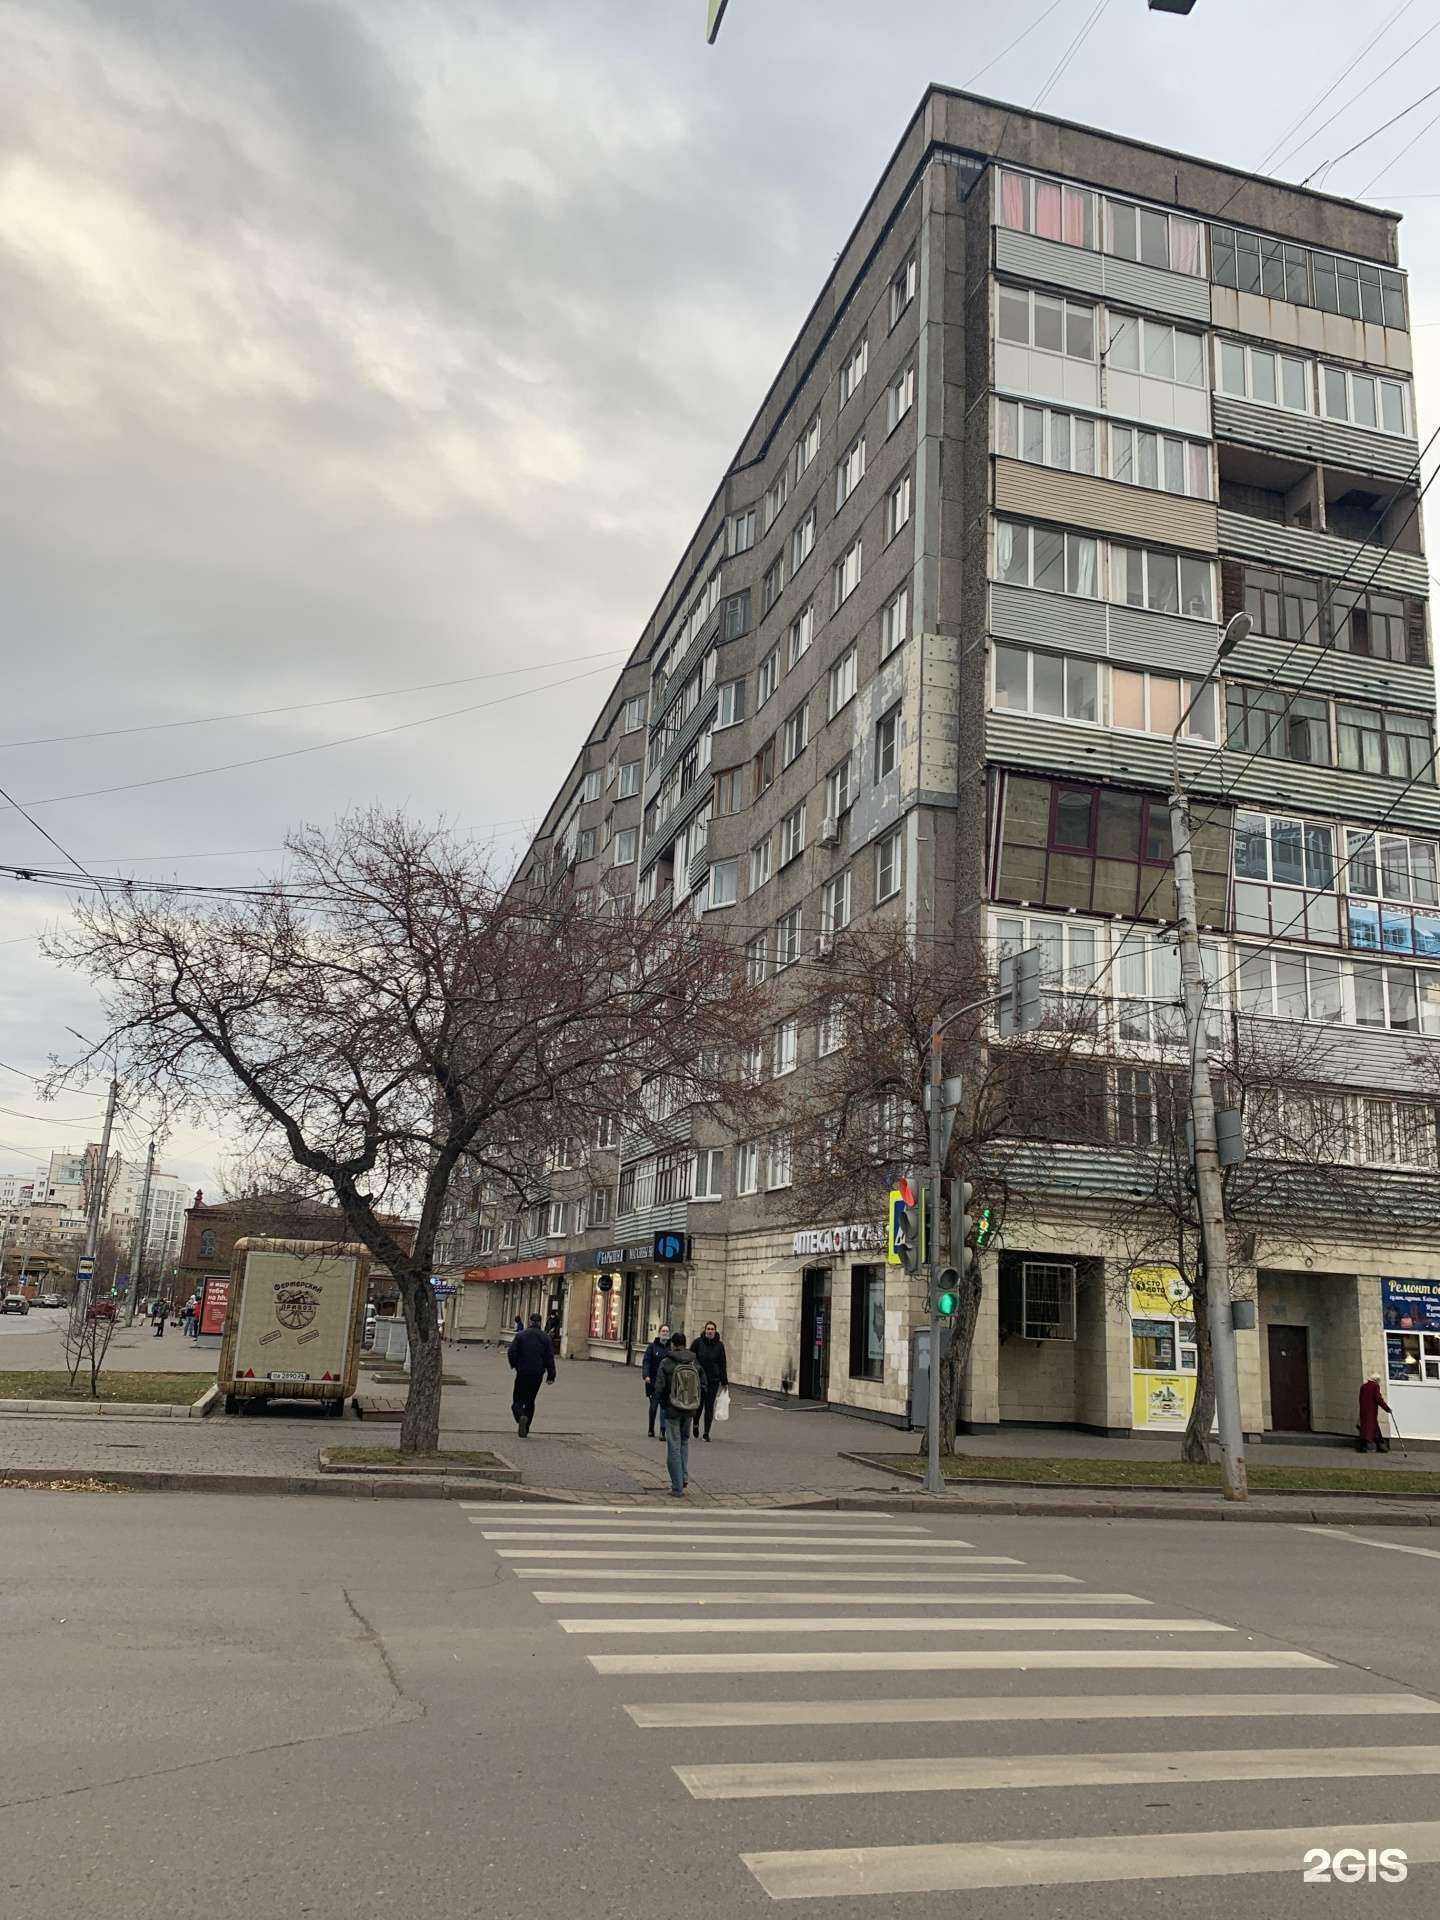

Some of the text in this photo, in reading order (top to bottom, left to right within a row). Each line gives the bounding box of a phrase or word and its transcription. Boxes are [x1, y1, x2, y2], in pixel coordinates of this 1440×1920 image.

[793, 1228, 832, 1254] АПТЕКА
[832, 1225, 849, 1251] ОТ
[274, 1281, 323, 1294] Фермерский
[1388, 1279, 1431, 1294] Ремонт
